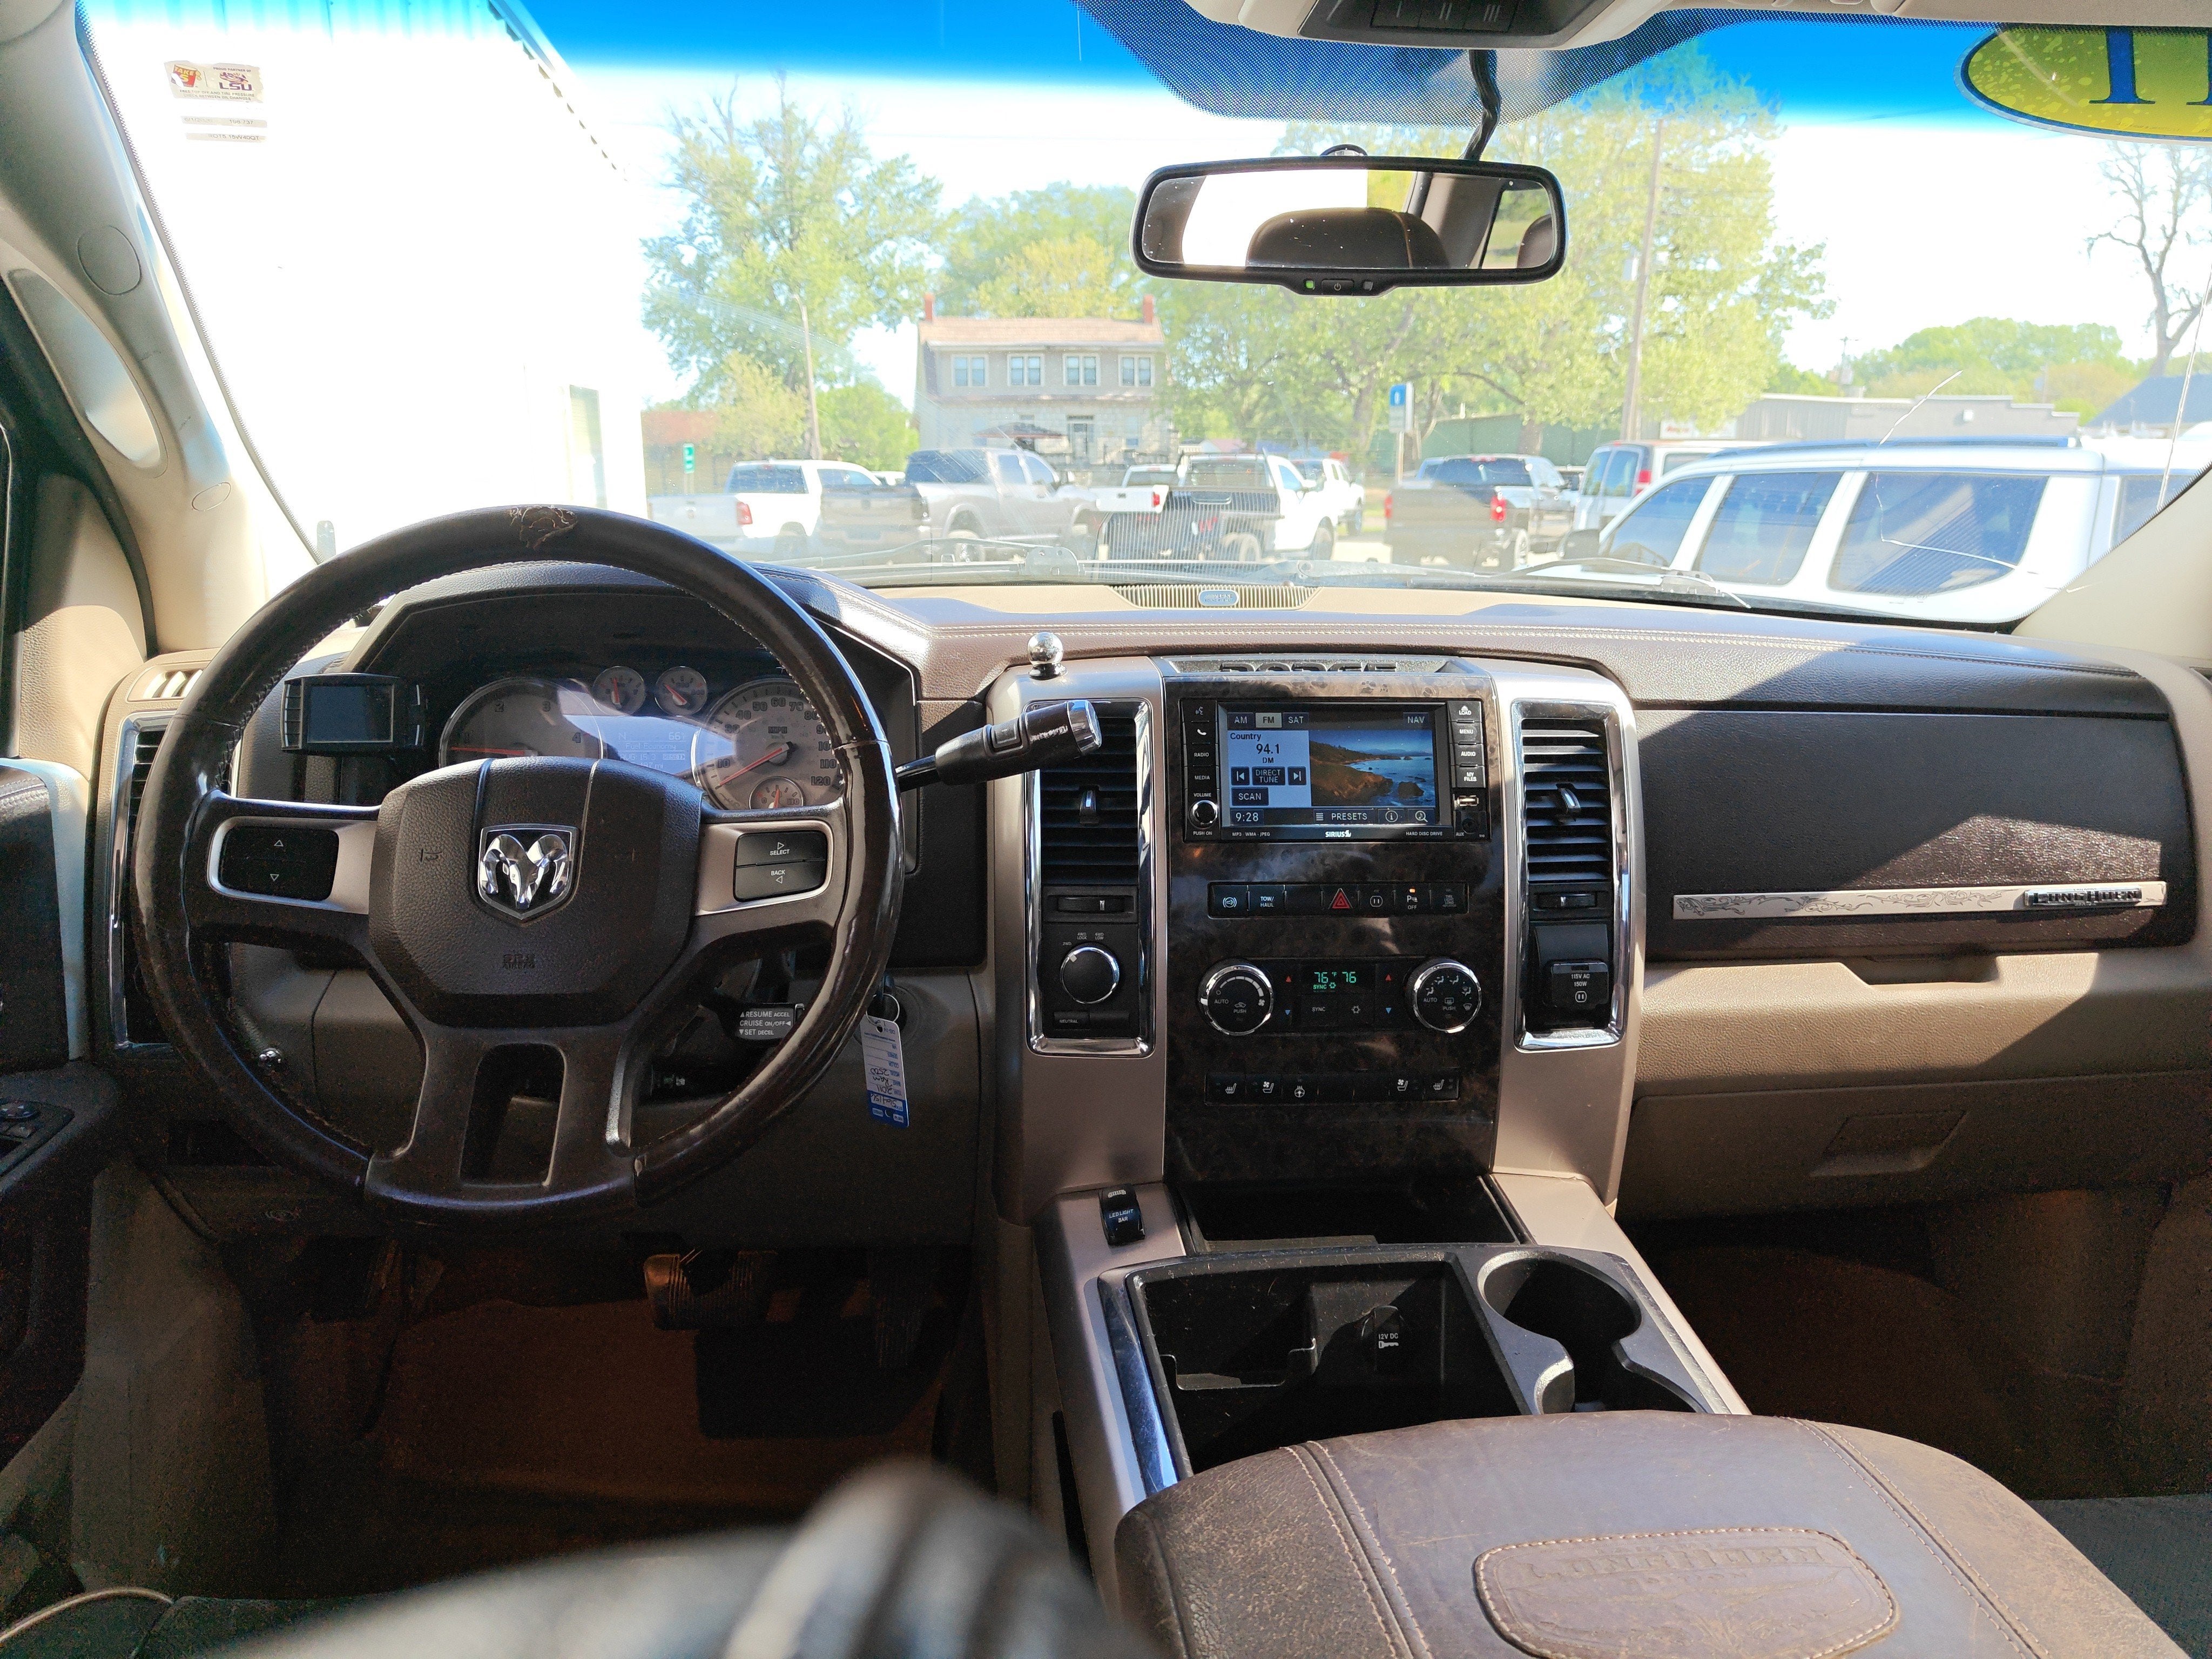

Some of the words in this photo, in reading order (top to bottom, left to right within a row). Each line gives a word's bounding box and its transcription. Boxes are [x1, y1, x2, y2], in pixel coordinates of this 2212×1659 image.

[219, 82, 252, 91] LSU
[752, 702, 767, 711] 50
[771, 697, 786, 707] 60
[789, 702, 804, 711] 70
[735, 710, 751, 720] 40
[1234, 716, 1247, 724] AM
[1288, 716, 1304, 724] SAT
[1407, 716, 1425, 724] NAV
[572, 732, 581, 744] 4
[618, 732, 626, 740] N
[1230, 732, 1262, 741] Country
[643, 743, 676, 751] Economy
[1256, 743, 1280, 754] 94.1
[717, 758, 730, 768] 10
[820, 759, 837, 769] 110
[811, 776, 831, 786] 120
[1238, 792, 1262, 801] SCAN
[1236, 812, 1259, 822] 9:28
[1331, 812, 1367, 821] PRESETS
[1314, 972, 1328, 983] 76
[1341, 972, 1357, 983] 76
[1518, 1544, 1833, 1579] LONGHORN
